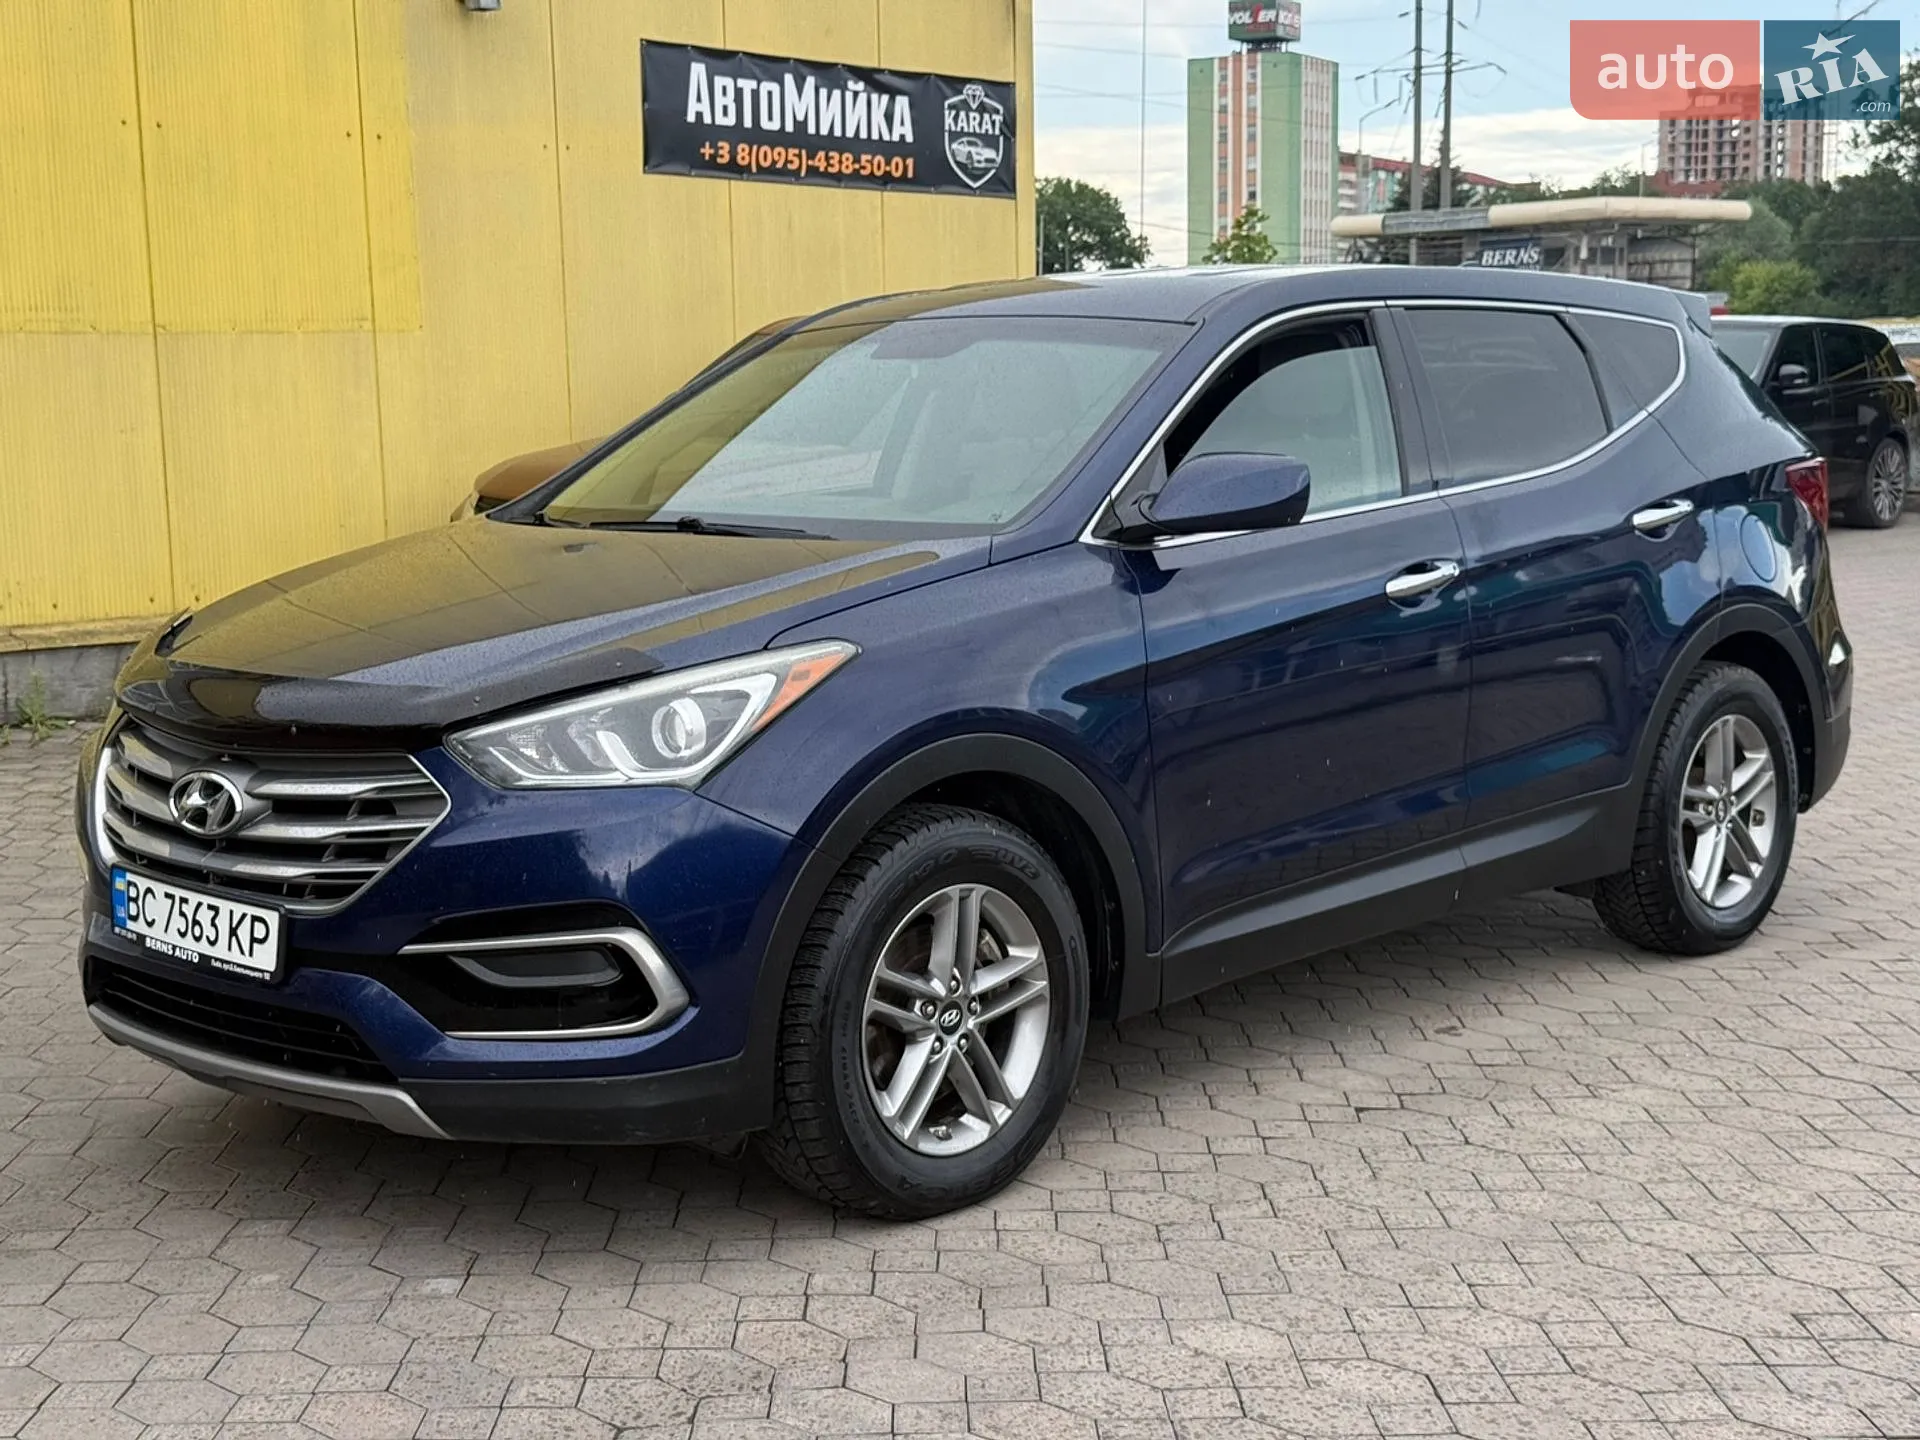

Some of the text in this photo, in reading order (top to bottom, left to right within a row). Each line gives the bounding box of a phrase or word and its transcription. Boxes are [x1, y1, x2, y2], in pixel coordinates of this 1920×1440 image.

[944, 109, 1004, 135] KARAT
[737, 145, 915, 179] 8(095)-438-50-01
[1481, 243, 1541, 266] BERNS
[127, 880, 270, 958] BC 7563 KP
[145, 937, 199, 963] BERNS AUTO
